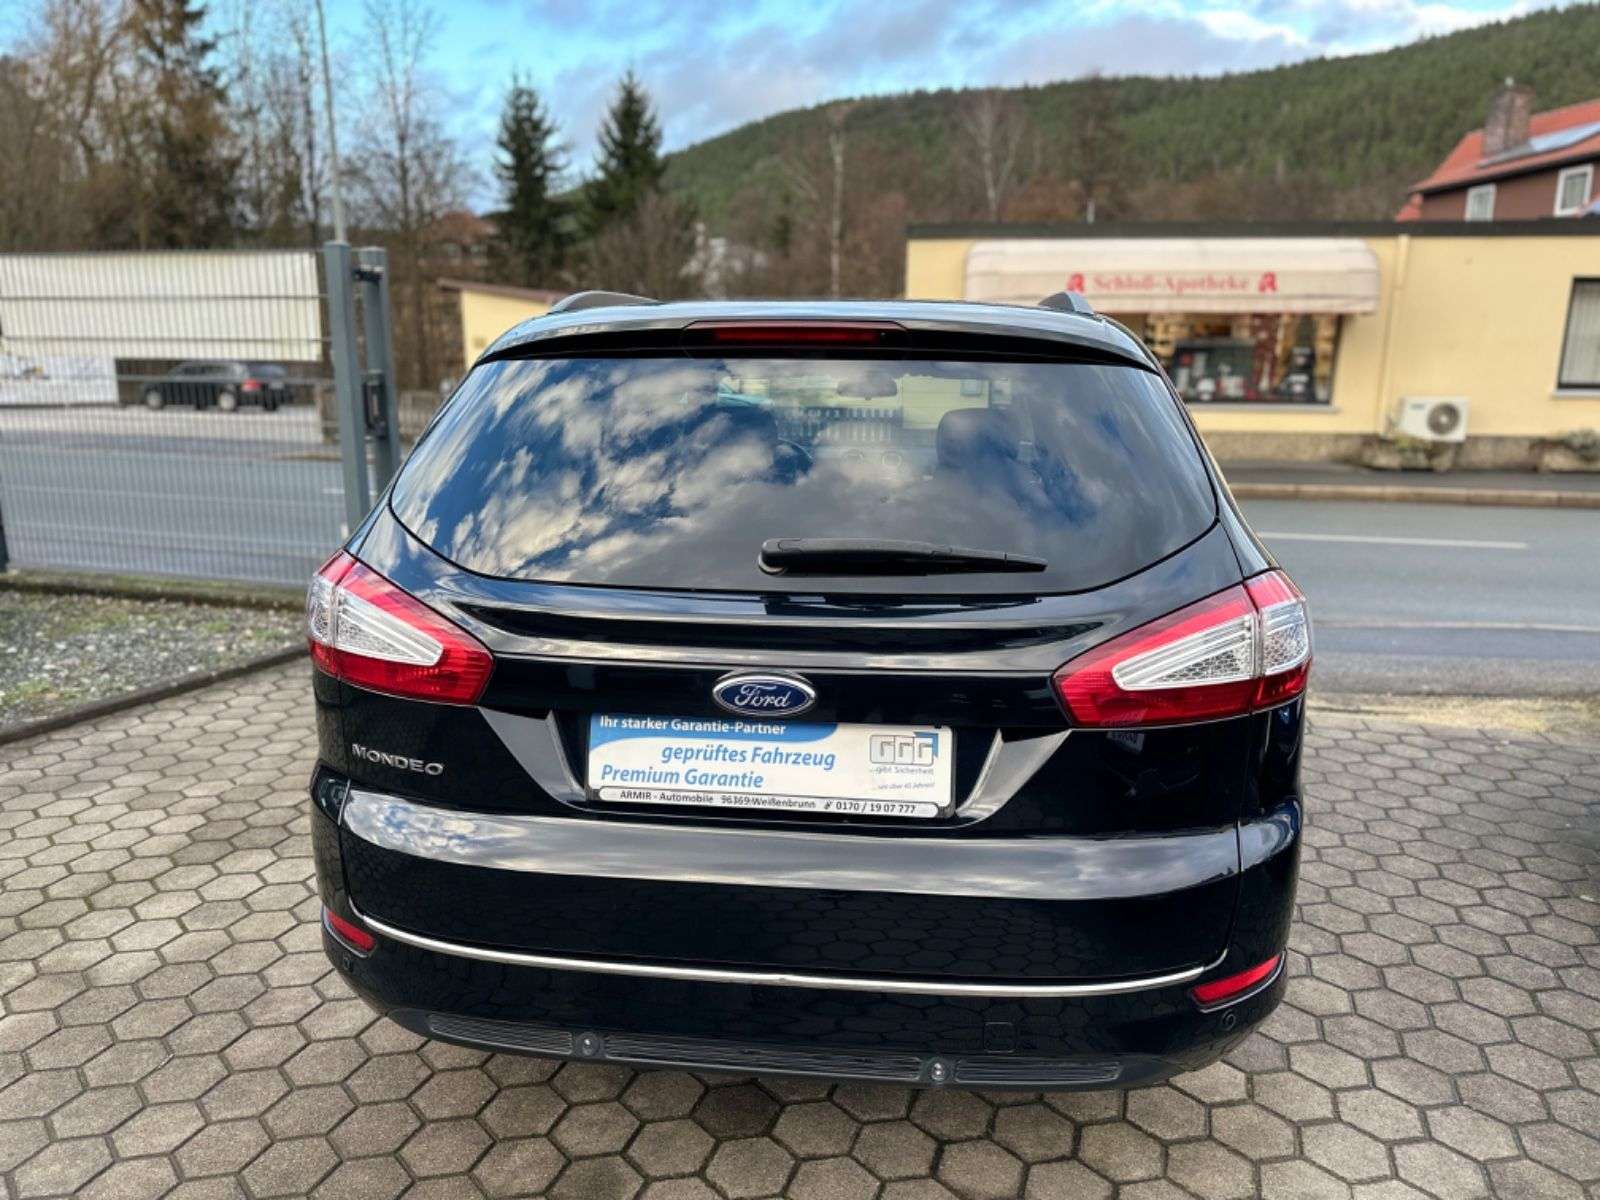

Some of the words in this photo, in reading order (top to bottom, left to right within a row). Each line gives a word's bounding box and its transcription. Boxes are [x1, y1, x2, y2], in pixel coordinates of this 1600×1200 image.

[734, 684, 792, 707] Ford
[600, 715, 618, 728] Ihr
[621, 717, 669, 730] starker
[671, 718, 786, 735] Garantie-Partner
[352, 743, 444, 775] MONDEO
[661, 744, 747, 764] geprüftes
[751, 746, 836, 771] Fahrzeug
[601, 764, 680, 785] Premium
[684, 767, 764, 788] Garantie
[659, 791, 713, 803] Automobile
[836, 801, 859, 812] 0170
